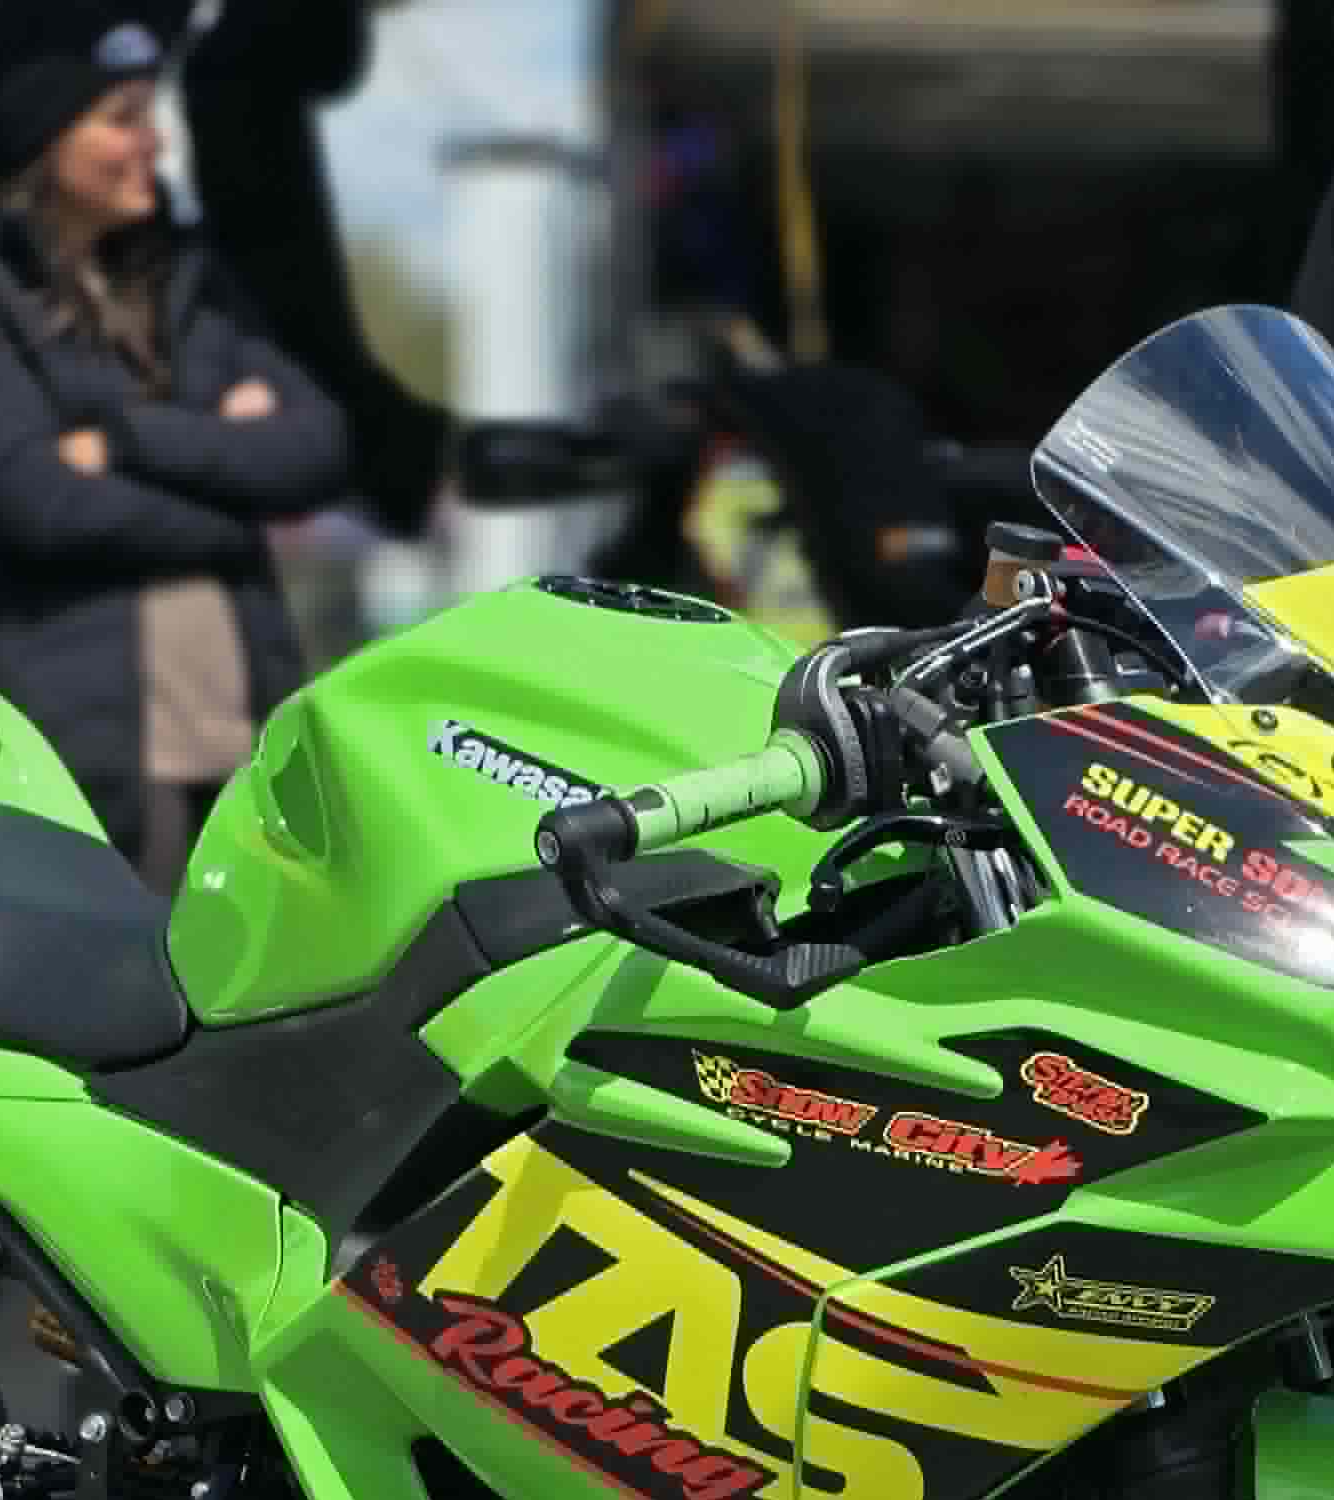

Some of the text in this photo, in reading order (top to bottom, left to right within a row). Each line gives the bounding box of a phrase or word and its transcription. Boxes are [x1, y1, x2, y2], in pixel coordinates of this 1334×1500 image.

[427, 718, 607, 808] Kawasa
[1063, 795, 1237, 897] ROAD RACE
[1082, 763, 1235, 864] SUPER
[725, 1105, 834, 1142] CYCLE
